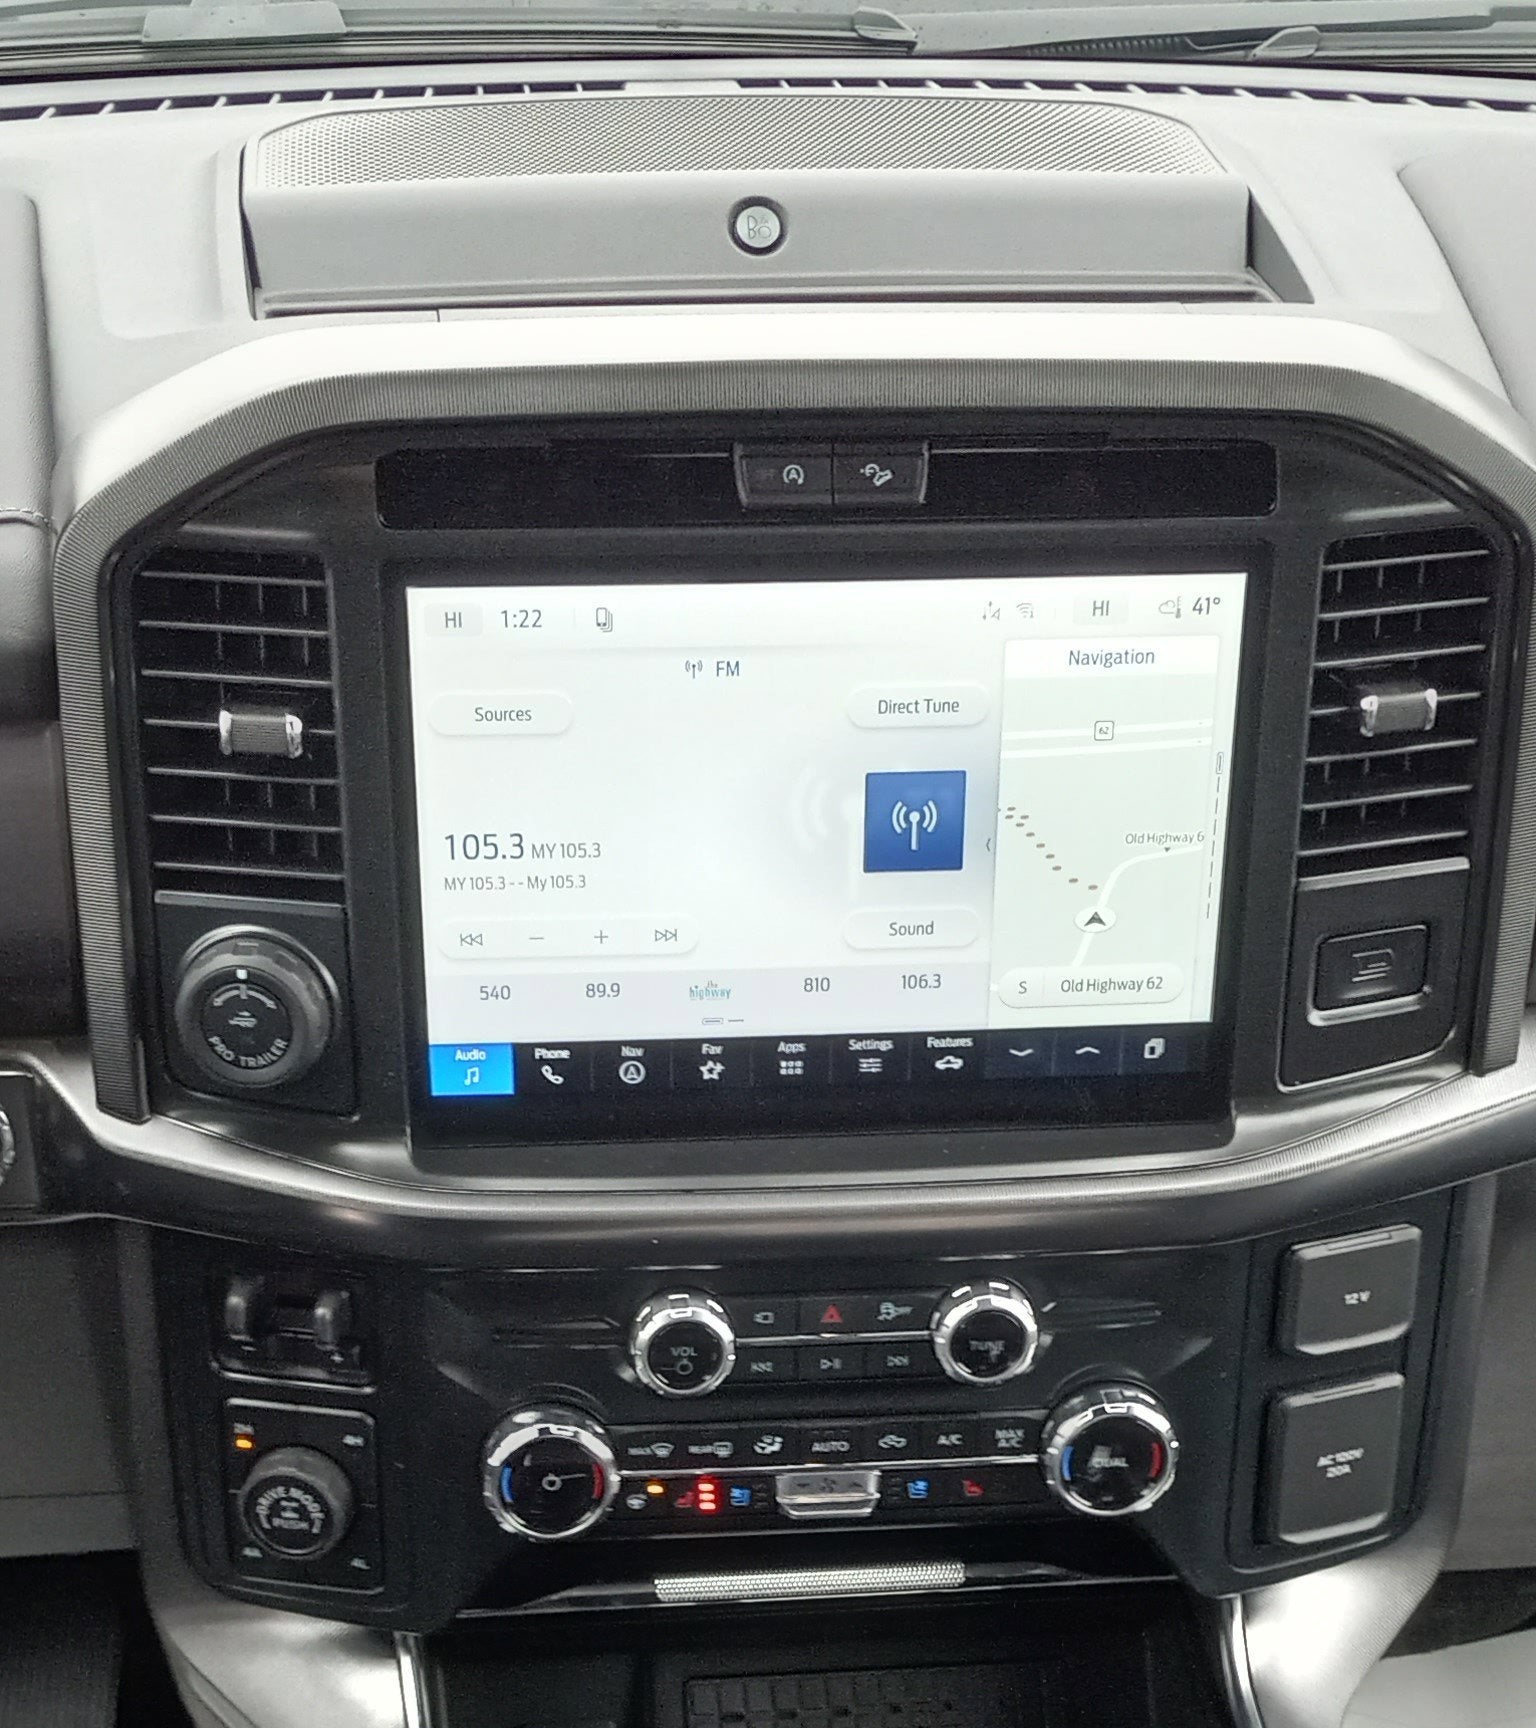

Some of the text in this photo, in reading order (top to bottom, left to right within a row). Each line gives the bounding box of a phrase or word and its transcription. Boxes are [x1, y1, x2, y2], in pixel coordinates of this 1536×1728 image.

[1092, 597, 1221, 617] HI 41°
[444, 609, 543, 629] HI 1:22
[1068, 648, 1155, 668] Navigation
[716, 661, 740, 677] FM
[474, 706, 532, 723] Sources
[877, 698, 960, 715] Direct Tune
[444, 832, 602, 861] 105.3 MY 105.3
[1125, 833, 1145, 844] Old
[1146, 832, 1195, 845] Highway
[444, 877, 466, 891] MY
[470, 876, 506, 890] 105.3
[527, 876, 547, 892] My
[550, 875, 586, 889] 105.3
[888, 920, 935, 937] Sound
[804, 977, 831, 993] 810
[901, 974, 942, 990] 106.3
[1018, 981, 1027, 995] S
[1061, 976, 1163, 994] Old Highway 62
[480, 984, 511, 1001] 540
[585, 982, 621, 999] 89.9
[689, 985, 732, 1000] highway
[777, 1041, 806, 1055] Apps
[848, 1038, 894, 1052] Settings
[926, 1036, 974, 1049] Features
[455, 1048, 486, 1061] Audio
[534, 1047, 571, 1060] Phone
[621, 1045, 645, 1058] Nav
[670, 1346, 698, 1357] VOL
[811, 1440, 851, 1453] AUTO
[937, 1434, 963, 1446] A/C
